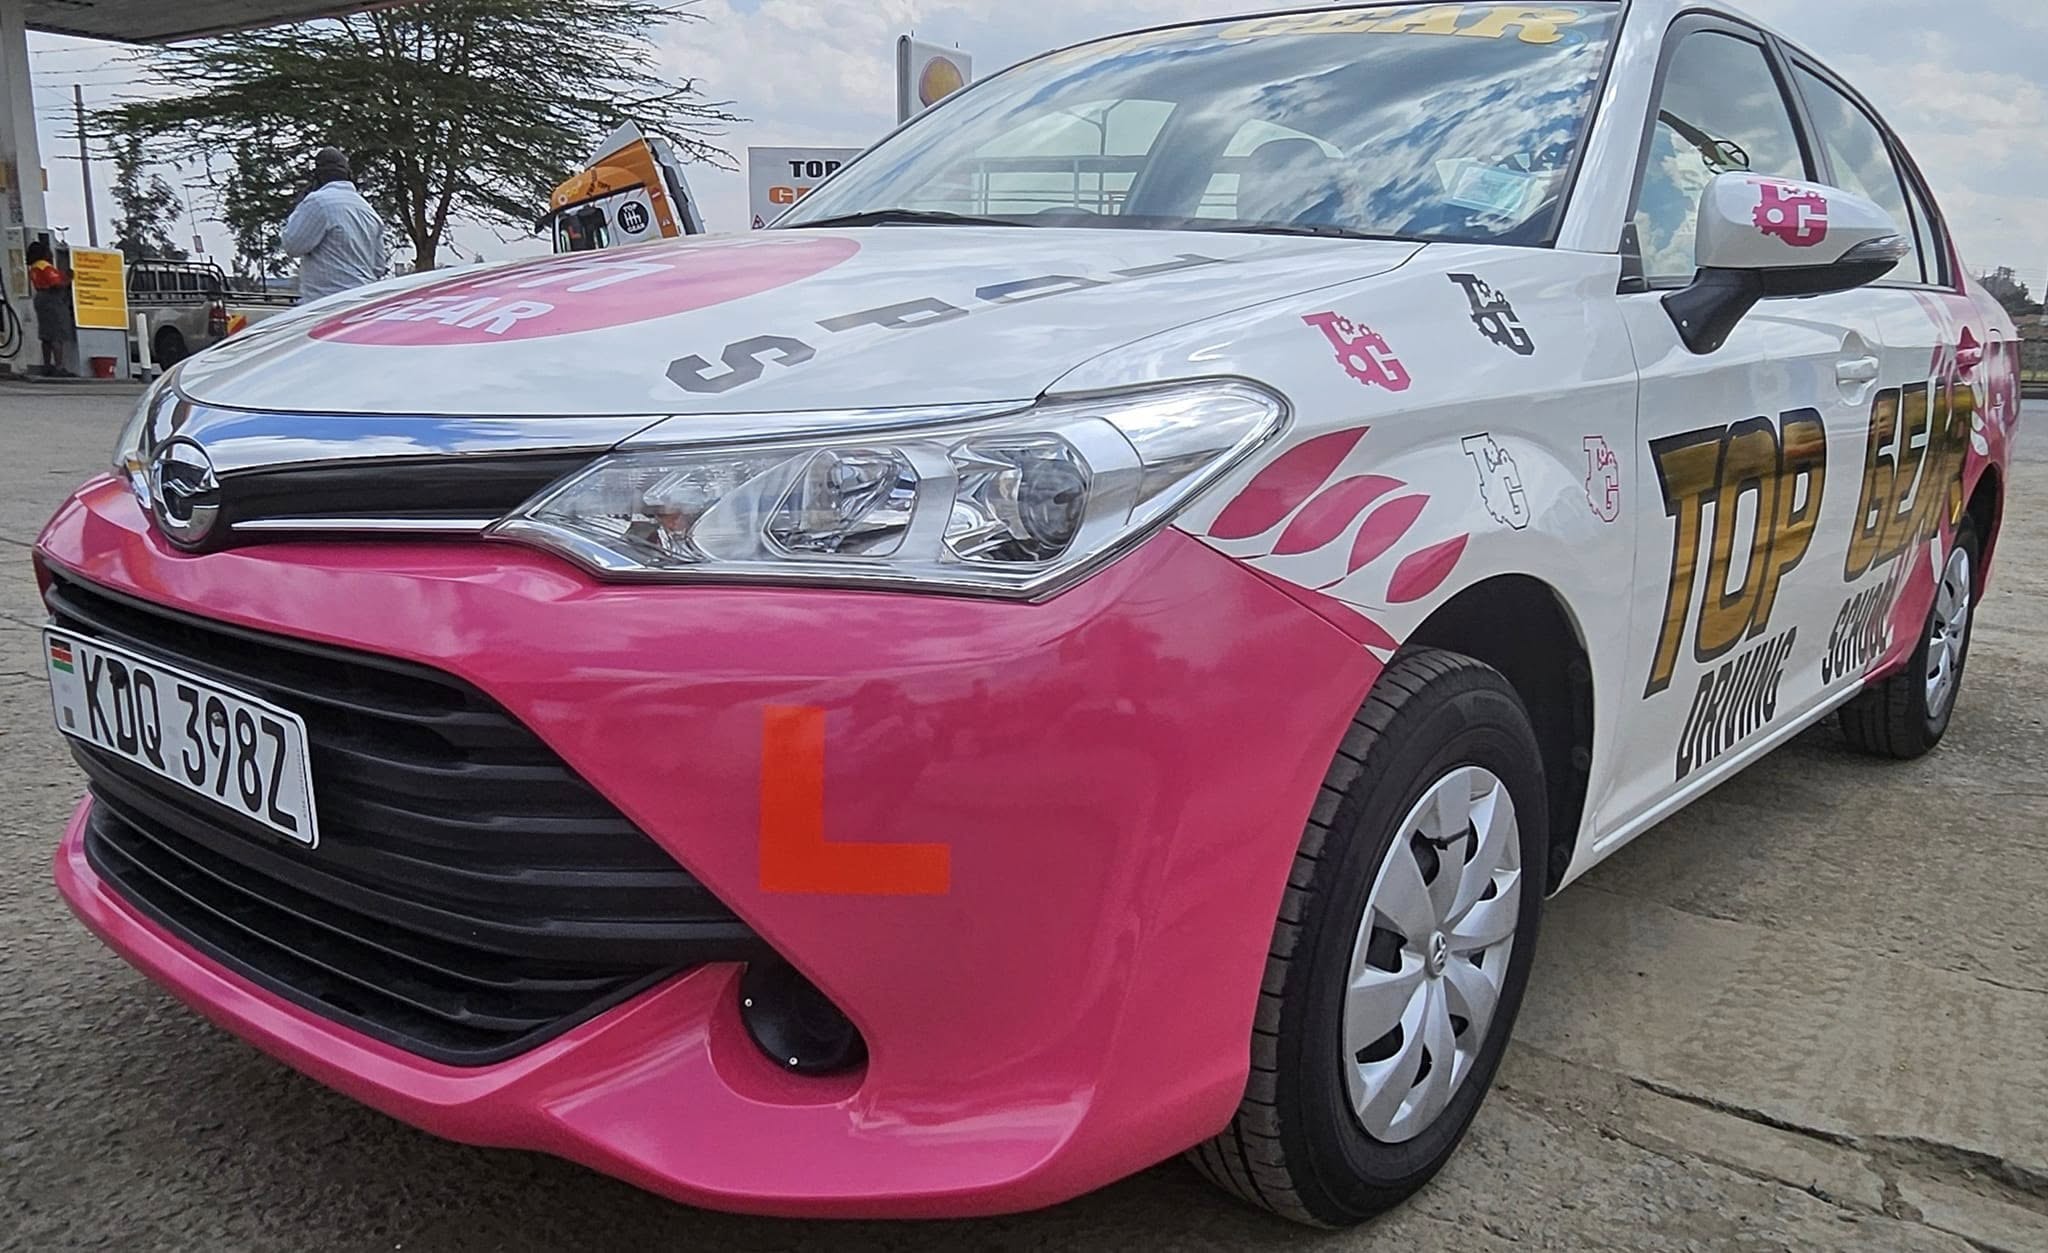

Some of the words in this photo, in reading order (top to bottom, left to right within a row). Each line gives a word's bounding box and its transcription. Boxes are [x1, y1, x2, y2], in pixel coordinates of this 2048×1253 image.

[1218, 4, 1580, 44] GEAR
[341, 296, 556, 335] GEAR
[1643, 406, 1827, 700] TOP
[80, 648, 166, 771] KDQ
[176, 683, 298, 833] 398Z
[1675, 625, 1798, 783] DRIVING
[760, 704, 950, 895] L
